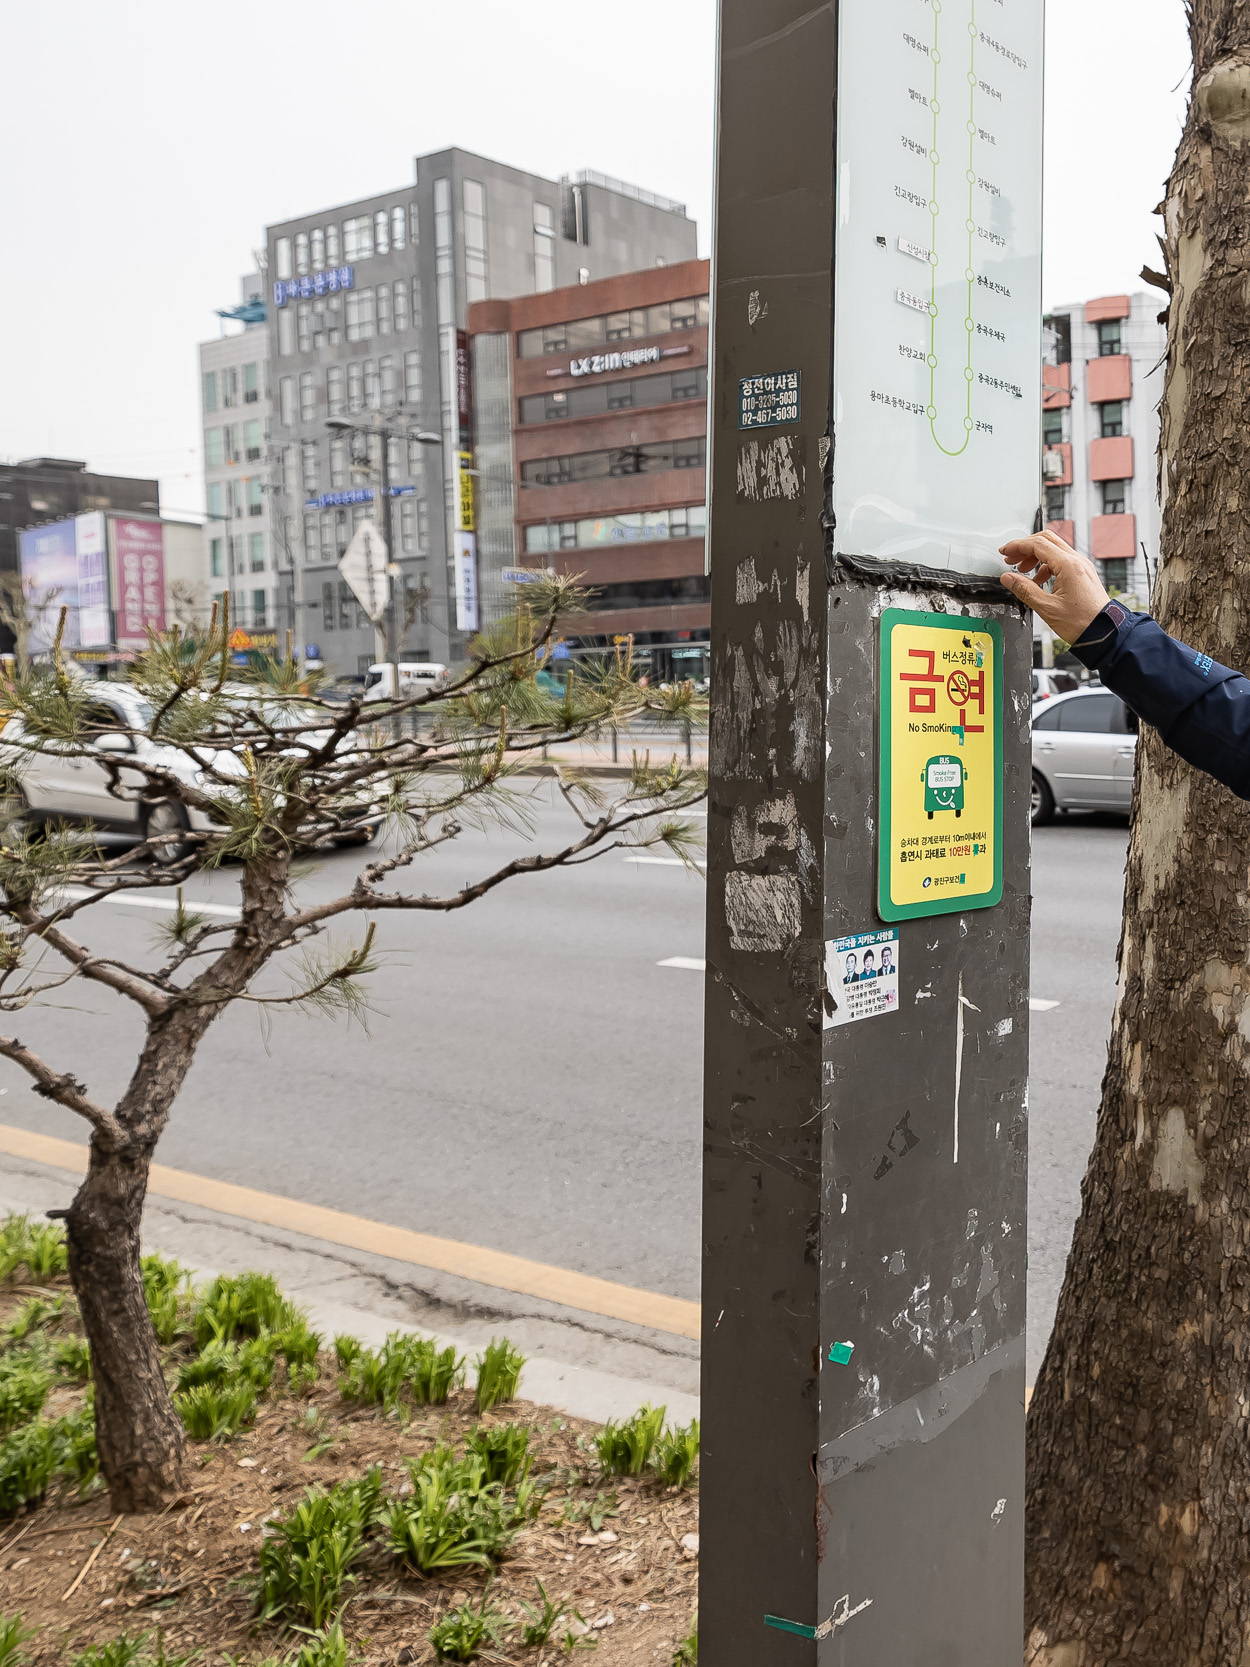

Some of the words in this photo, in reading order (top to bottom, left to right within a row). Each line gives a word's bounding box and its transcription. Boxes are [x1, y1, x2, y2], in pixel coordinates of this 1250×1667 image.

[869, 389, 926, 416] 용마초등학교입구
[742, 405, 797, 426] 02-467-5030
[975, 420, 993, 435] 군자역
[908, 722, 920, 733] No
[921, 723, 958, 734] SmoKin
[939, 756, 950, 765] BUS
[900, 837, 920, 848] 승차대
[920, 834, 951, 846] 경계로부터
[899, 849, 923, 863] 흡연시
[924, 847, 947, 860] 과태료
[948, 844, 971, 857] 10만원
[933, 873, 966, 886] 광진구보건
